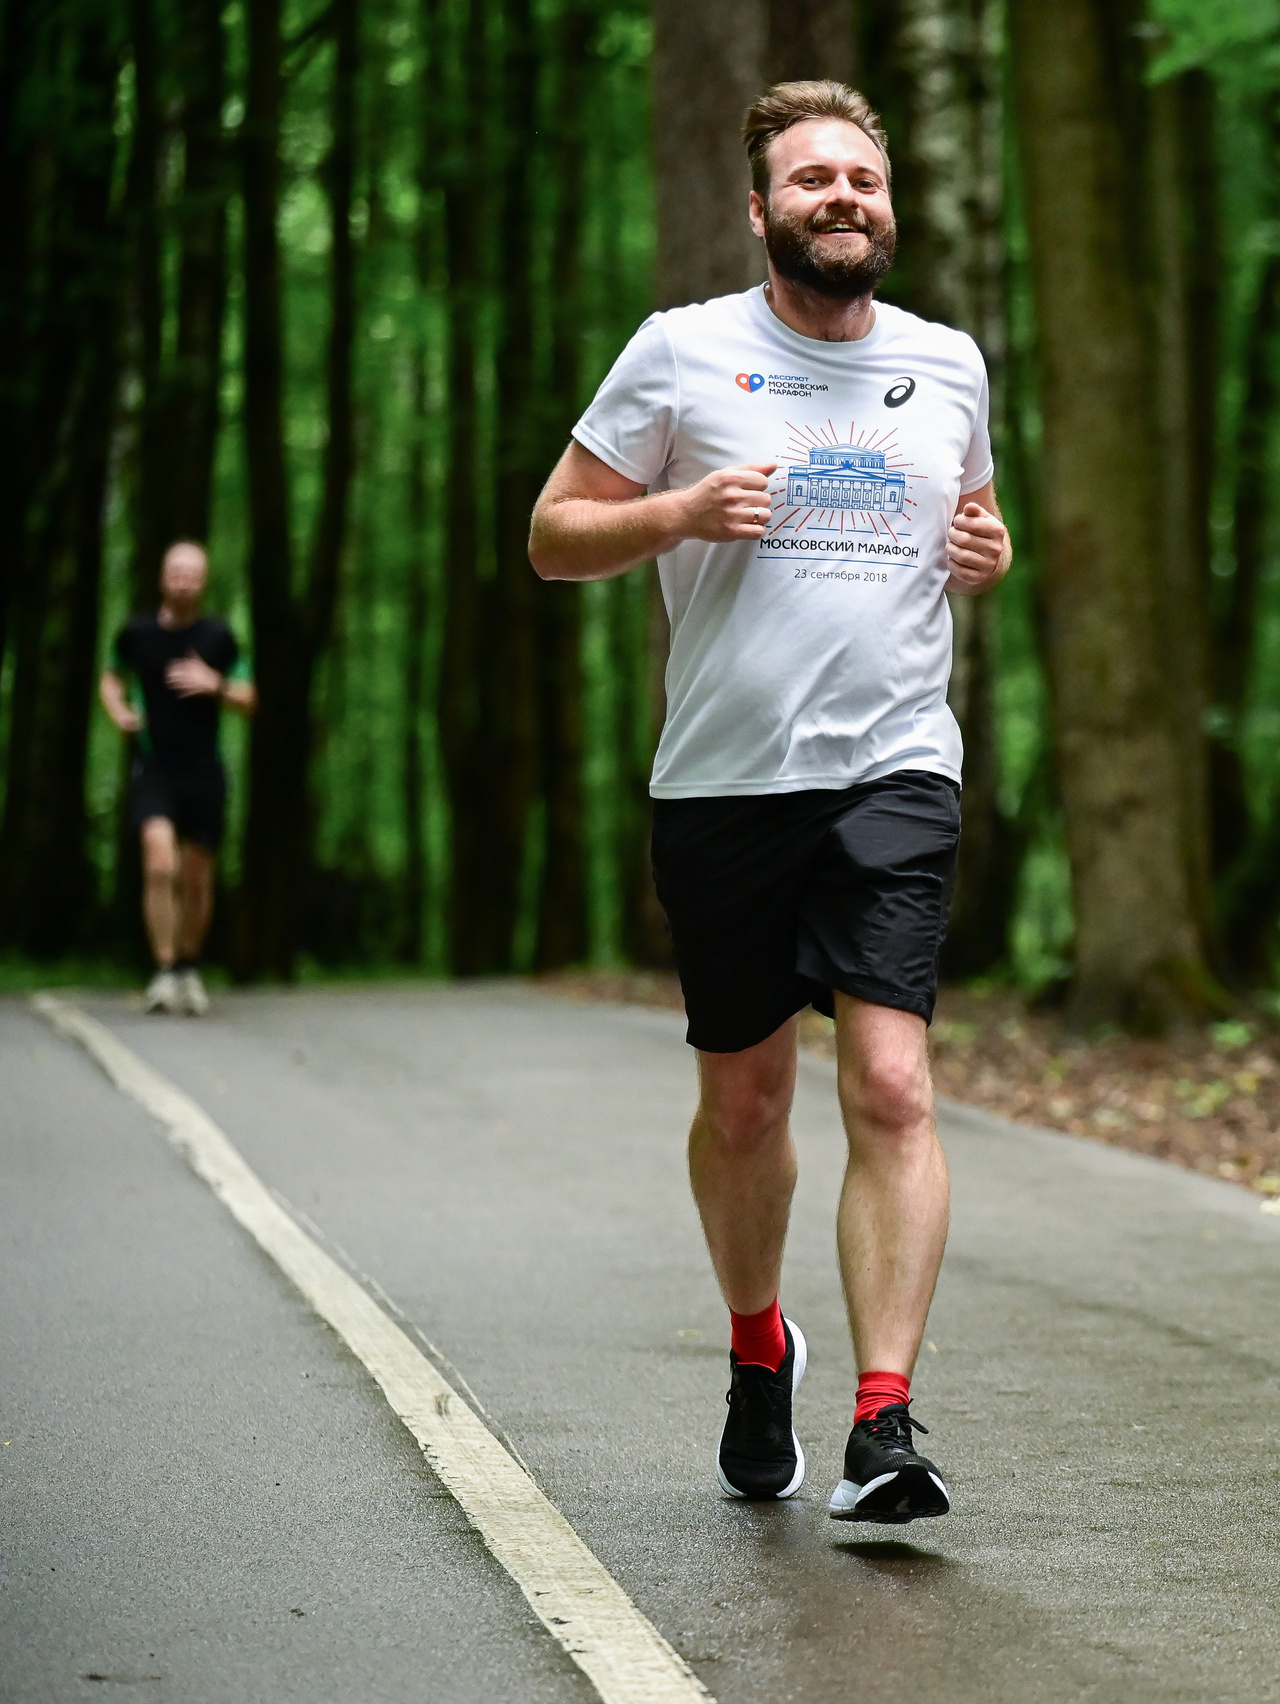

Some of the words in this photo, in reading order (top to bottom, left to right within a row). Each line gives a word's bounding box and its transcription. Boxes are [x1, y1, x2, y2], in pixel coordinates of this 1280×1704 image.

[768, 374, 809, 382] АБСОЛЮТ
[768, 381, 829, 391] МОСКОВСКИЙ
[769, 388, 812, 398] МАРАФОН
[760, 538, 854, 552] МОСКОВСКИЙ
[857, 542, 919, 558] МАРАФОН
[794, 568, 807, 579] 23
[810, 570, 860, 582] сентября
[863, 572, 888, 583] 2018
